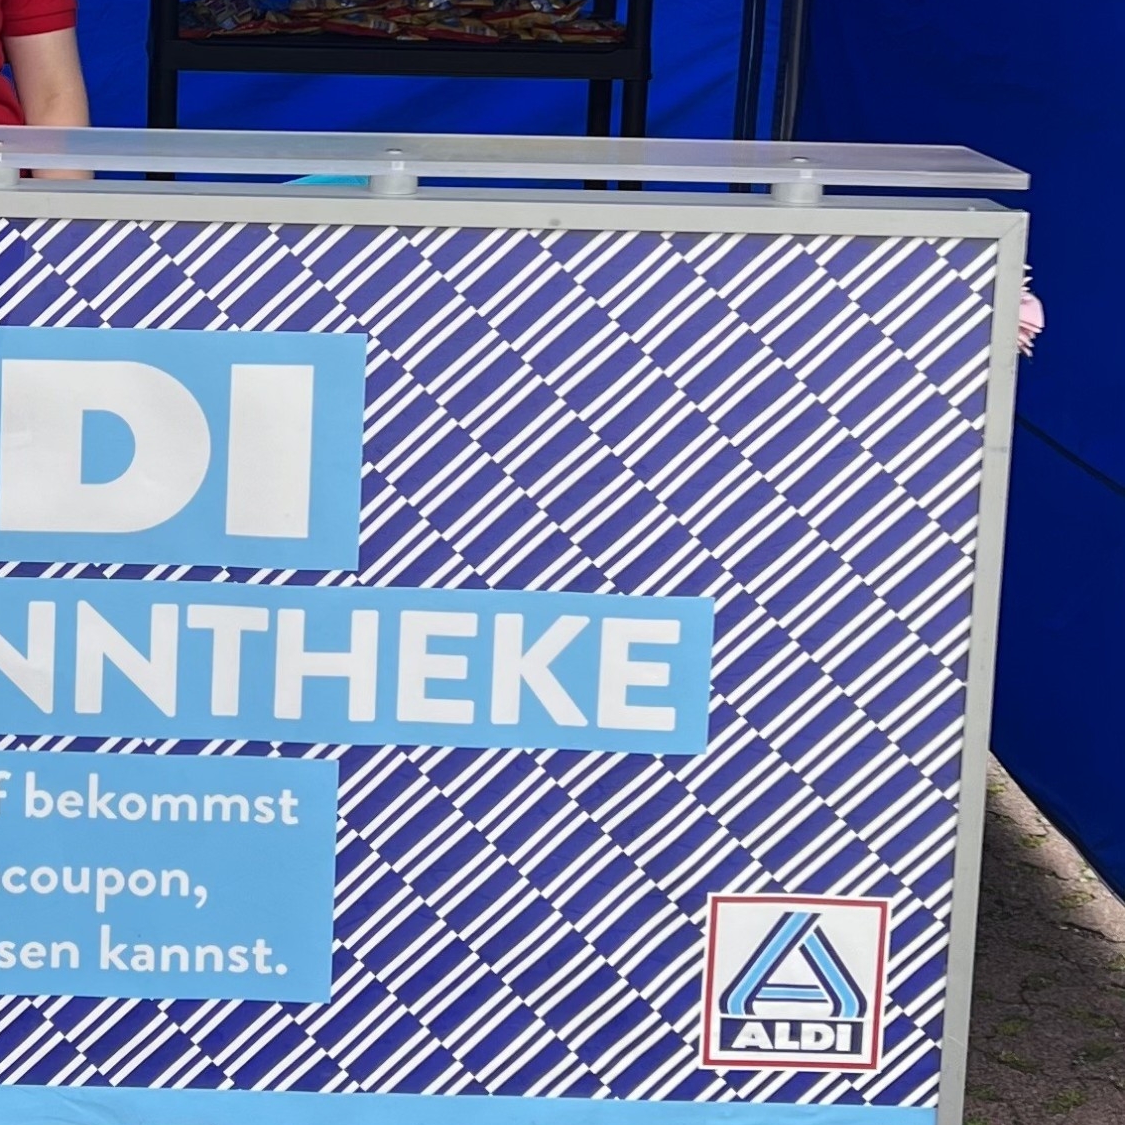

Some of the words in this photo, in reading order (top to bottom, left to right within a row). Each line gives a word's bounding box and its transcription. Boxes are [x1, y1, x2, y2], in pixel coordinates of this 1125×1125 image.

[26, 772, 299, 824] bekommst
[101, 925, 287, 974] kannst.
[731, 1021, 852, 1053] ALDI
